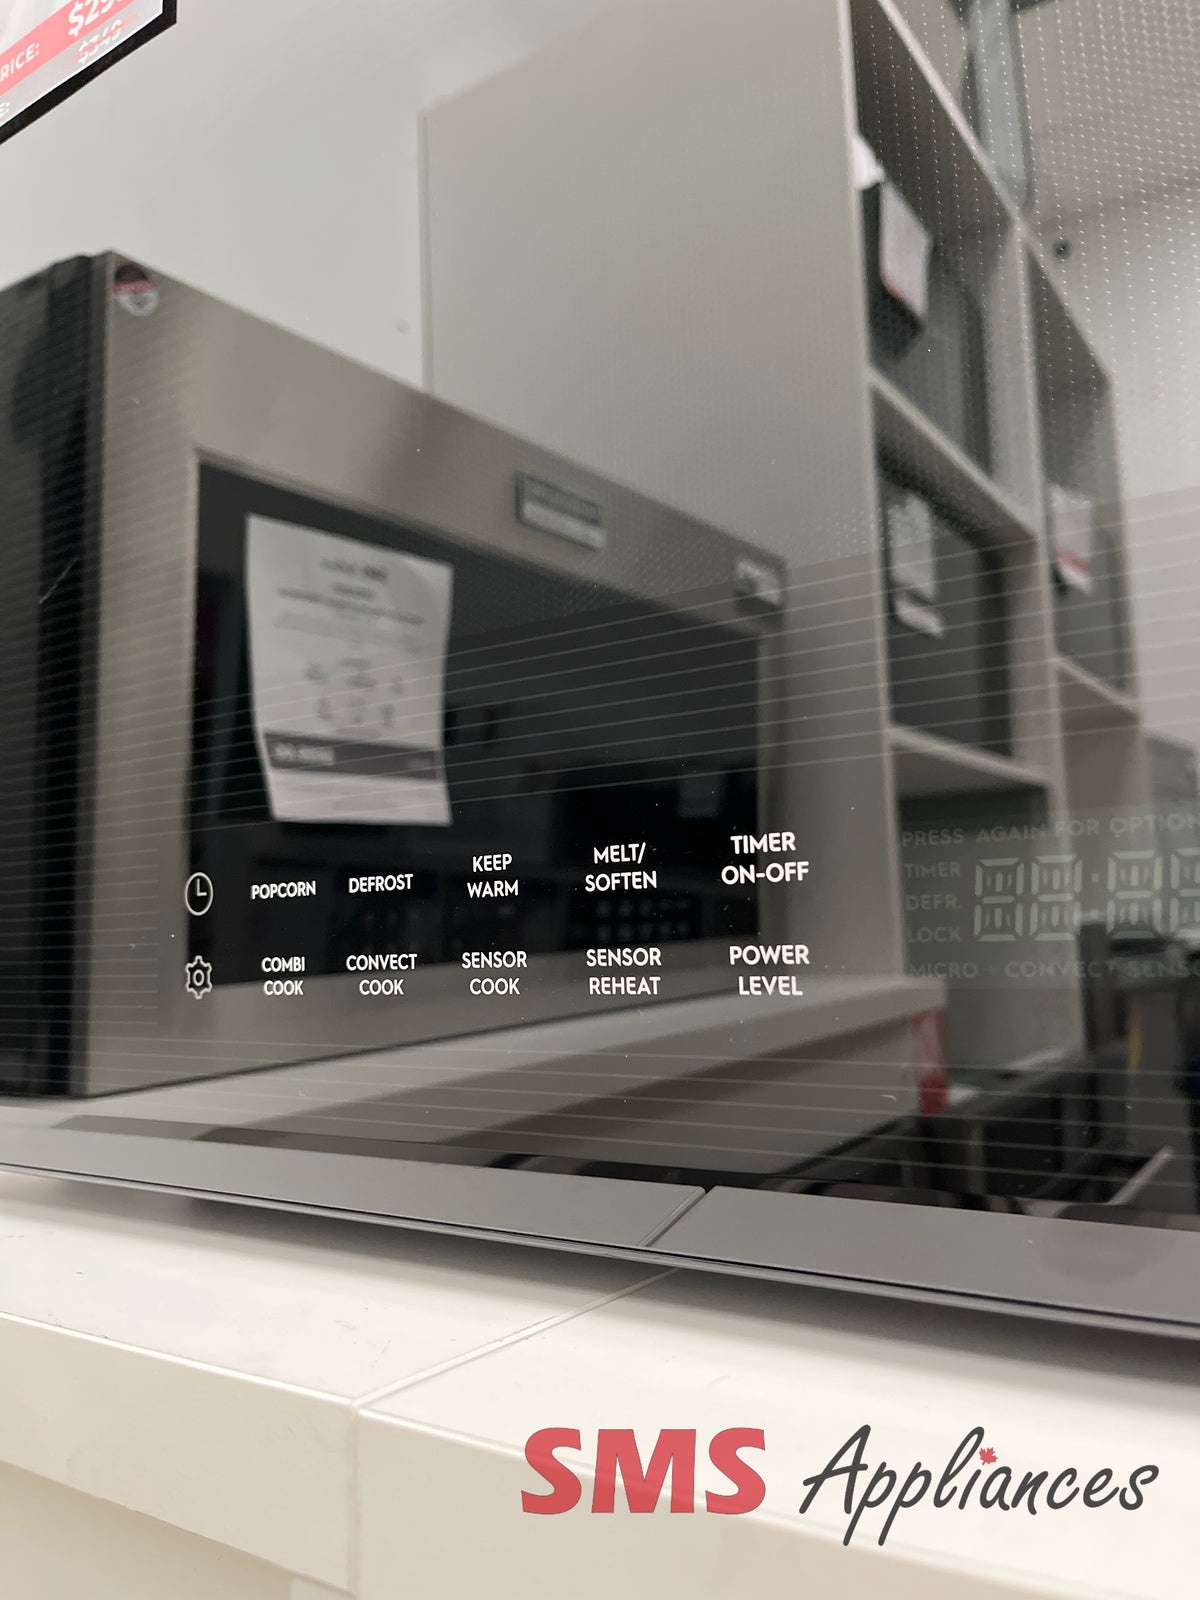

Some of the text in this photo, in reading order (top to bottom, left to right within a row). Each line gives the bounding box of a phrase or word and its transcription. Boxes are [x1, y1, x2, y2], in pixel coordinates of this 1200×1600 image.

[68, 0, 123, 37] $29
[730, 831, 797, 855] TIMER
[902, 828, 964, 847] PRESS
[976, 824, 1047, 843] AGAIN
[1055, 819, 1100, 837] FOR
[472, 853, 513, 873] KEEP
[593, 842, 647, 864] MELT/
[721, 860, 810, 885] ON-OFF
[905, 861, 961, 879] TIMER
[251, 880, 316, 900] POPCORN
[348, 873, 414, 894] DEFROST
[466, 879, 519, 899] WARM
[584, 870, 657, 892] SOFTEN
[905, 894, 962, 911] DEFR.
[907, 926, 962, 944] LOCK
[261, 956, 306, 973] COMBI
[346, 953, 418, 971] CONVECT
[461, 950, 528, 969] SENSOR
[586, 947, 662, 967] SENSOR
[729, 944, 810, 966] POWER
[909, 961, 978, 979] MICRO
[1005, 960, 1119, 978] CONVECT
[263, 979, 304, 997] COOK
[359, 978, 405, 996] COOK
[469, 977, 521, 996] COOK
[589, 976, 661, 995] REHEAT
[738, 975, 804, 997] LEVEL
